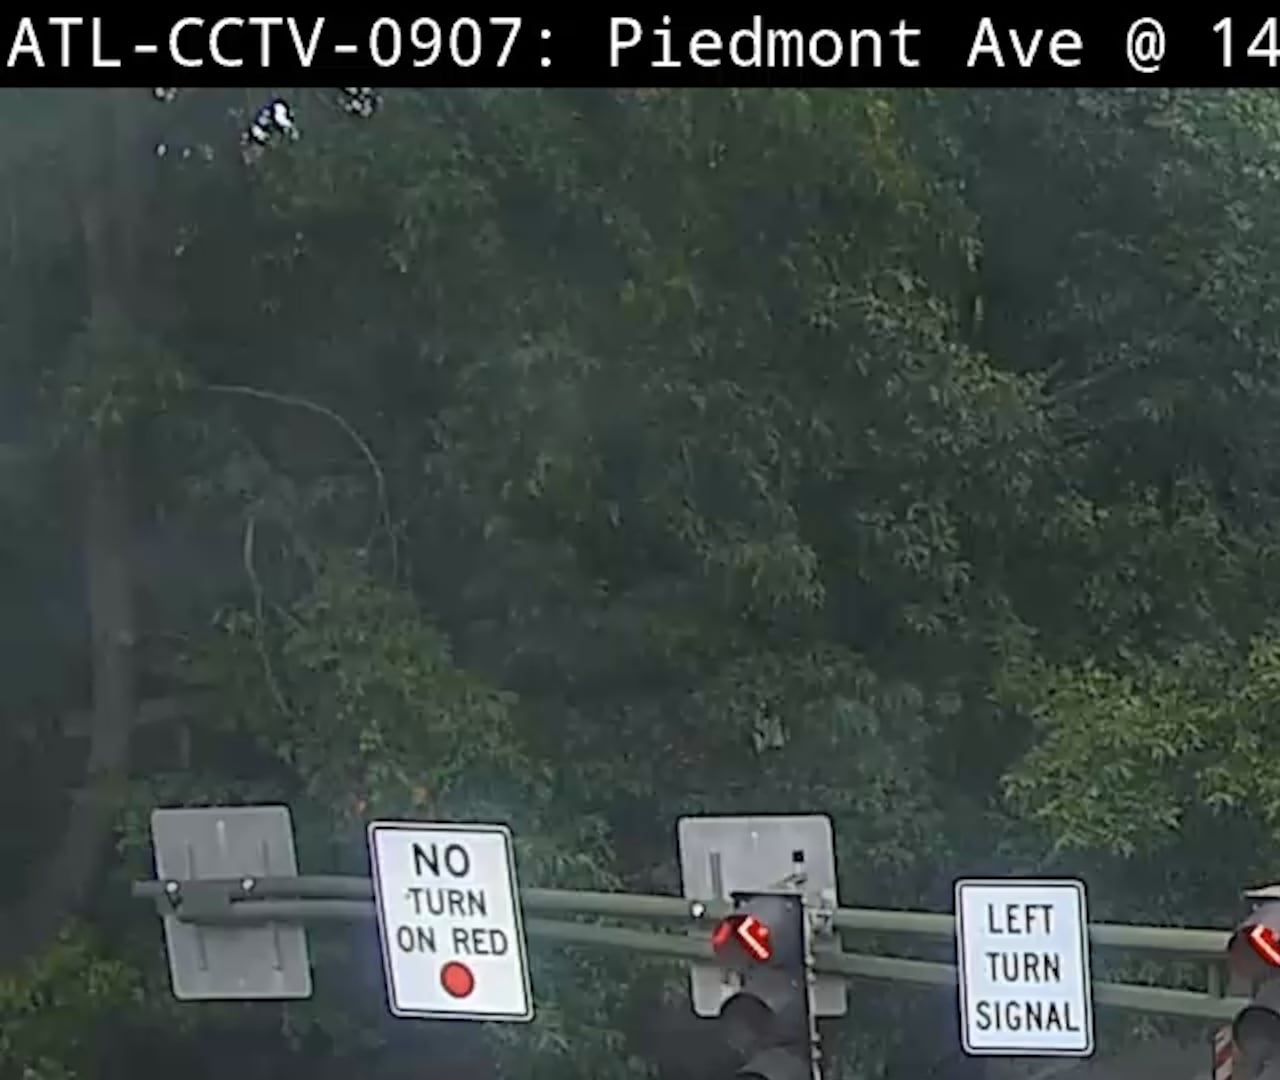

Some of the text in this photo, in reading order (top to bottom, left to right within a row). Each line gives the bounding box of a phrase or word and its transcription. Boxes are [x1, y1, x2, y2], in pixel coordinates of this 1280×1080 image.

[413, 844, 469, 877] NO
[409, 888, 486, 915] TURN
[989, 904, 1053, 933] LEFT
[398, 926, 507, 955] ON RED
[987, 953, 1060, 981] TURN
[977, 1001, 1079, 1031] SIGNAL
